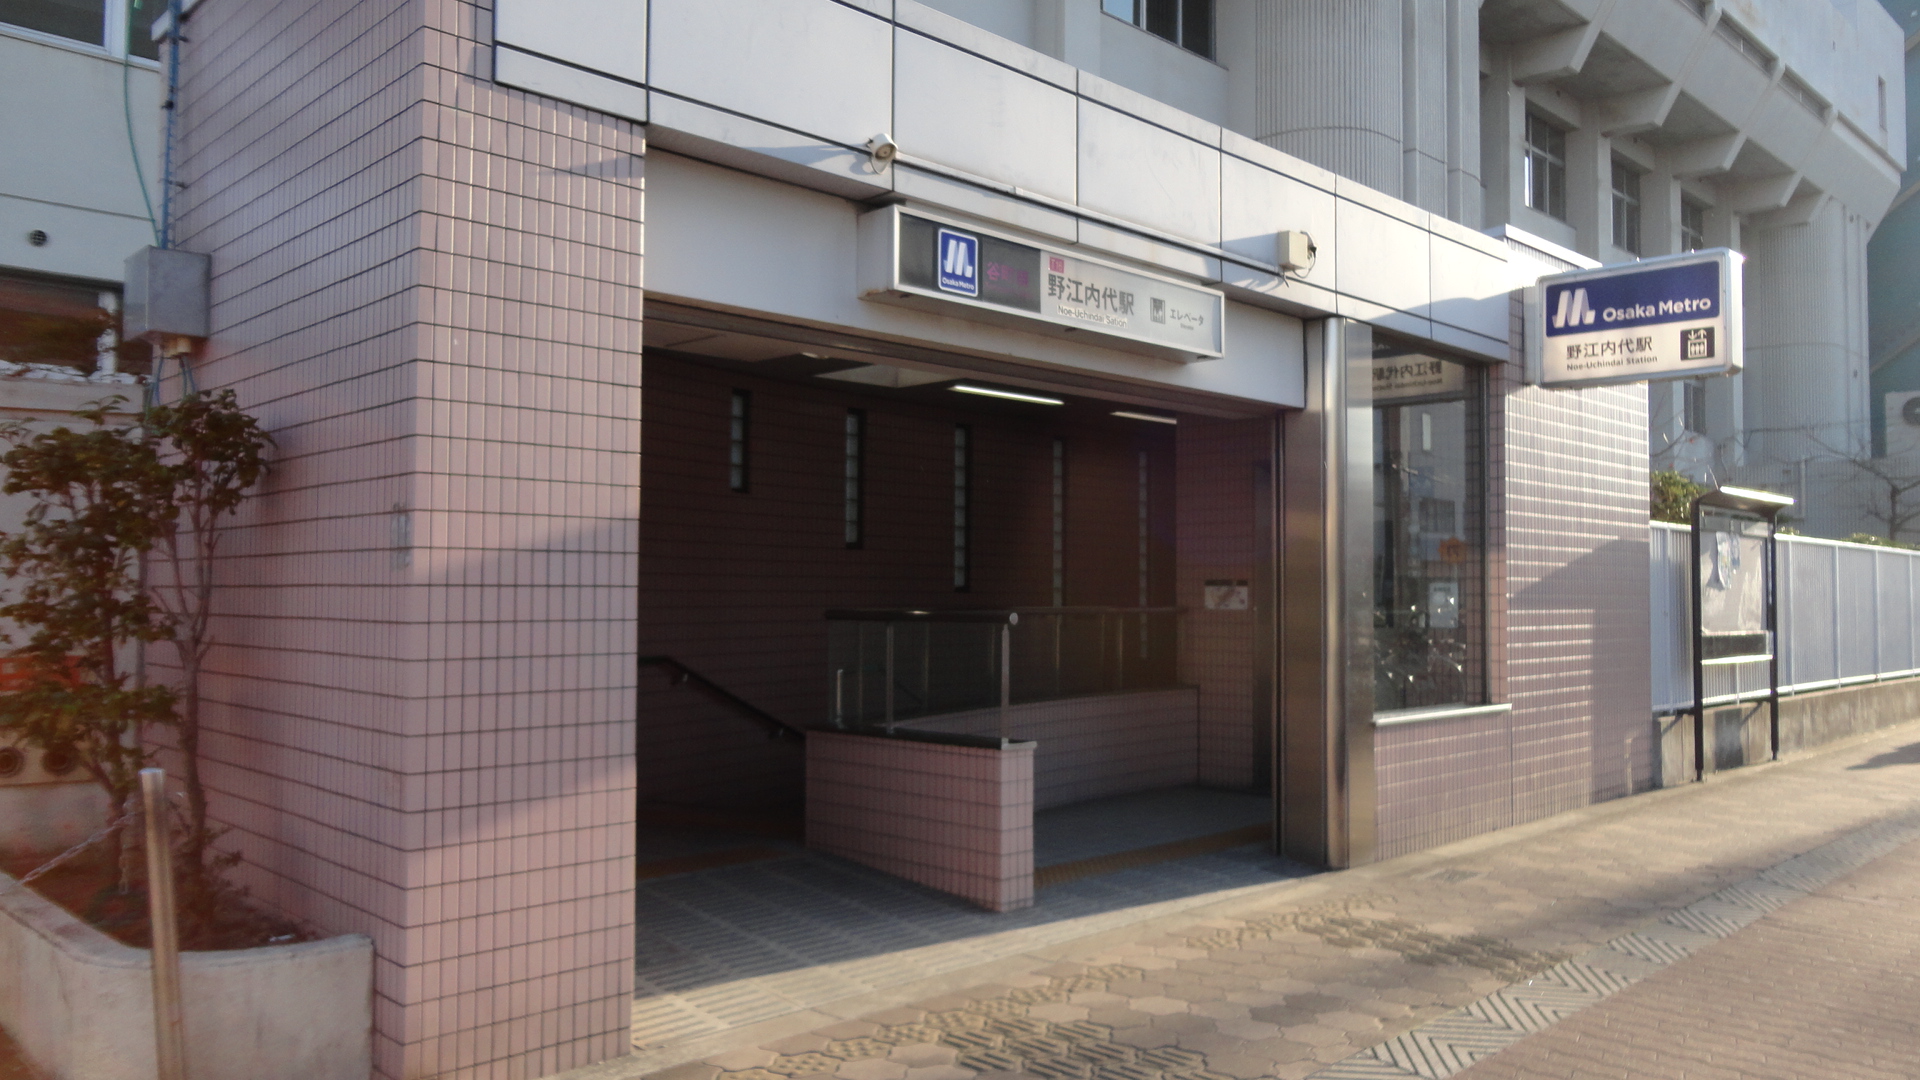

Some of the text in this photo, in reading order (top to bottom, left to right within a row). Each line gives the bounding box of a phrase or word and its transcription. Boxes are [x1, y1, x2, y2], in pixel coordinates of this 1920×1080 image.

[942, 277, 958, 288] Osaka
[959, 281, 974, 290] Metro
[1048, 273, 1134, 315] 野江内代駅
[1058, 305, 1104, 322] Noe-Uchindai
[1170, 308, 1204, 326] エレベータ
[1602, 297, 1712, 322] Osaka Metro
[1566, 336, 1653, 360] 野江内代駅
[1566, 355, 1658, 372] Noe-Uchindai Station
